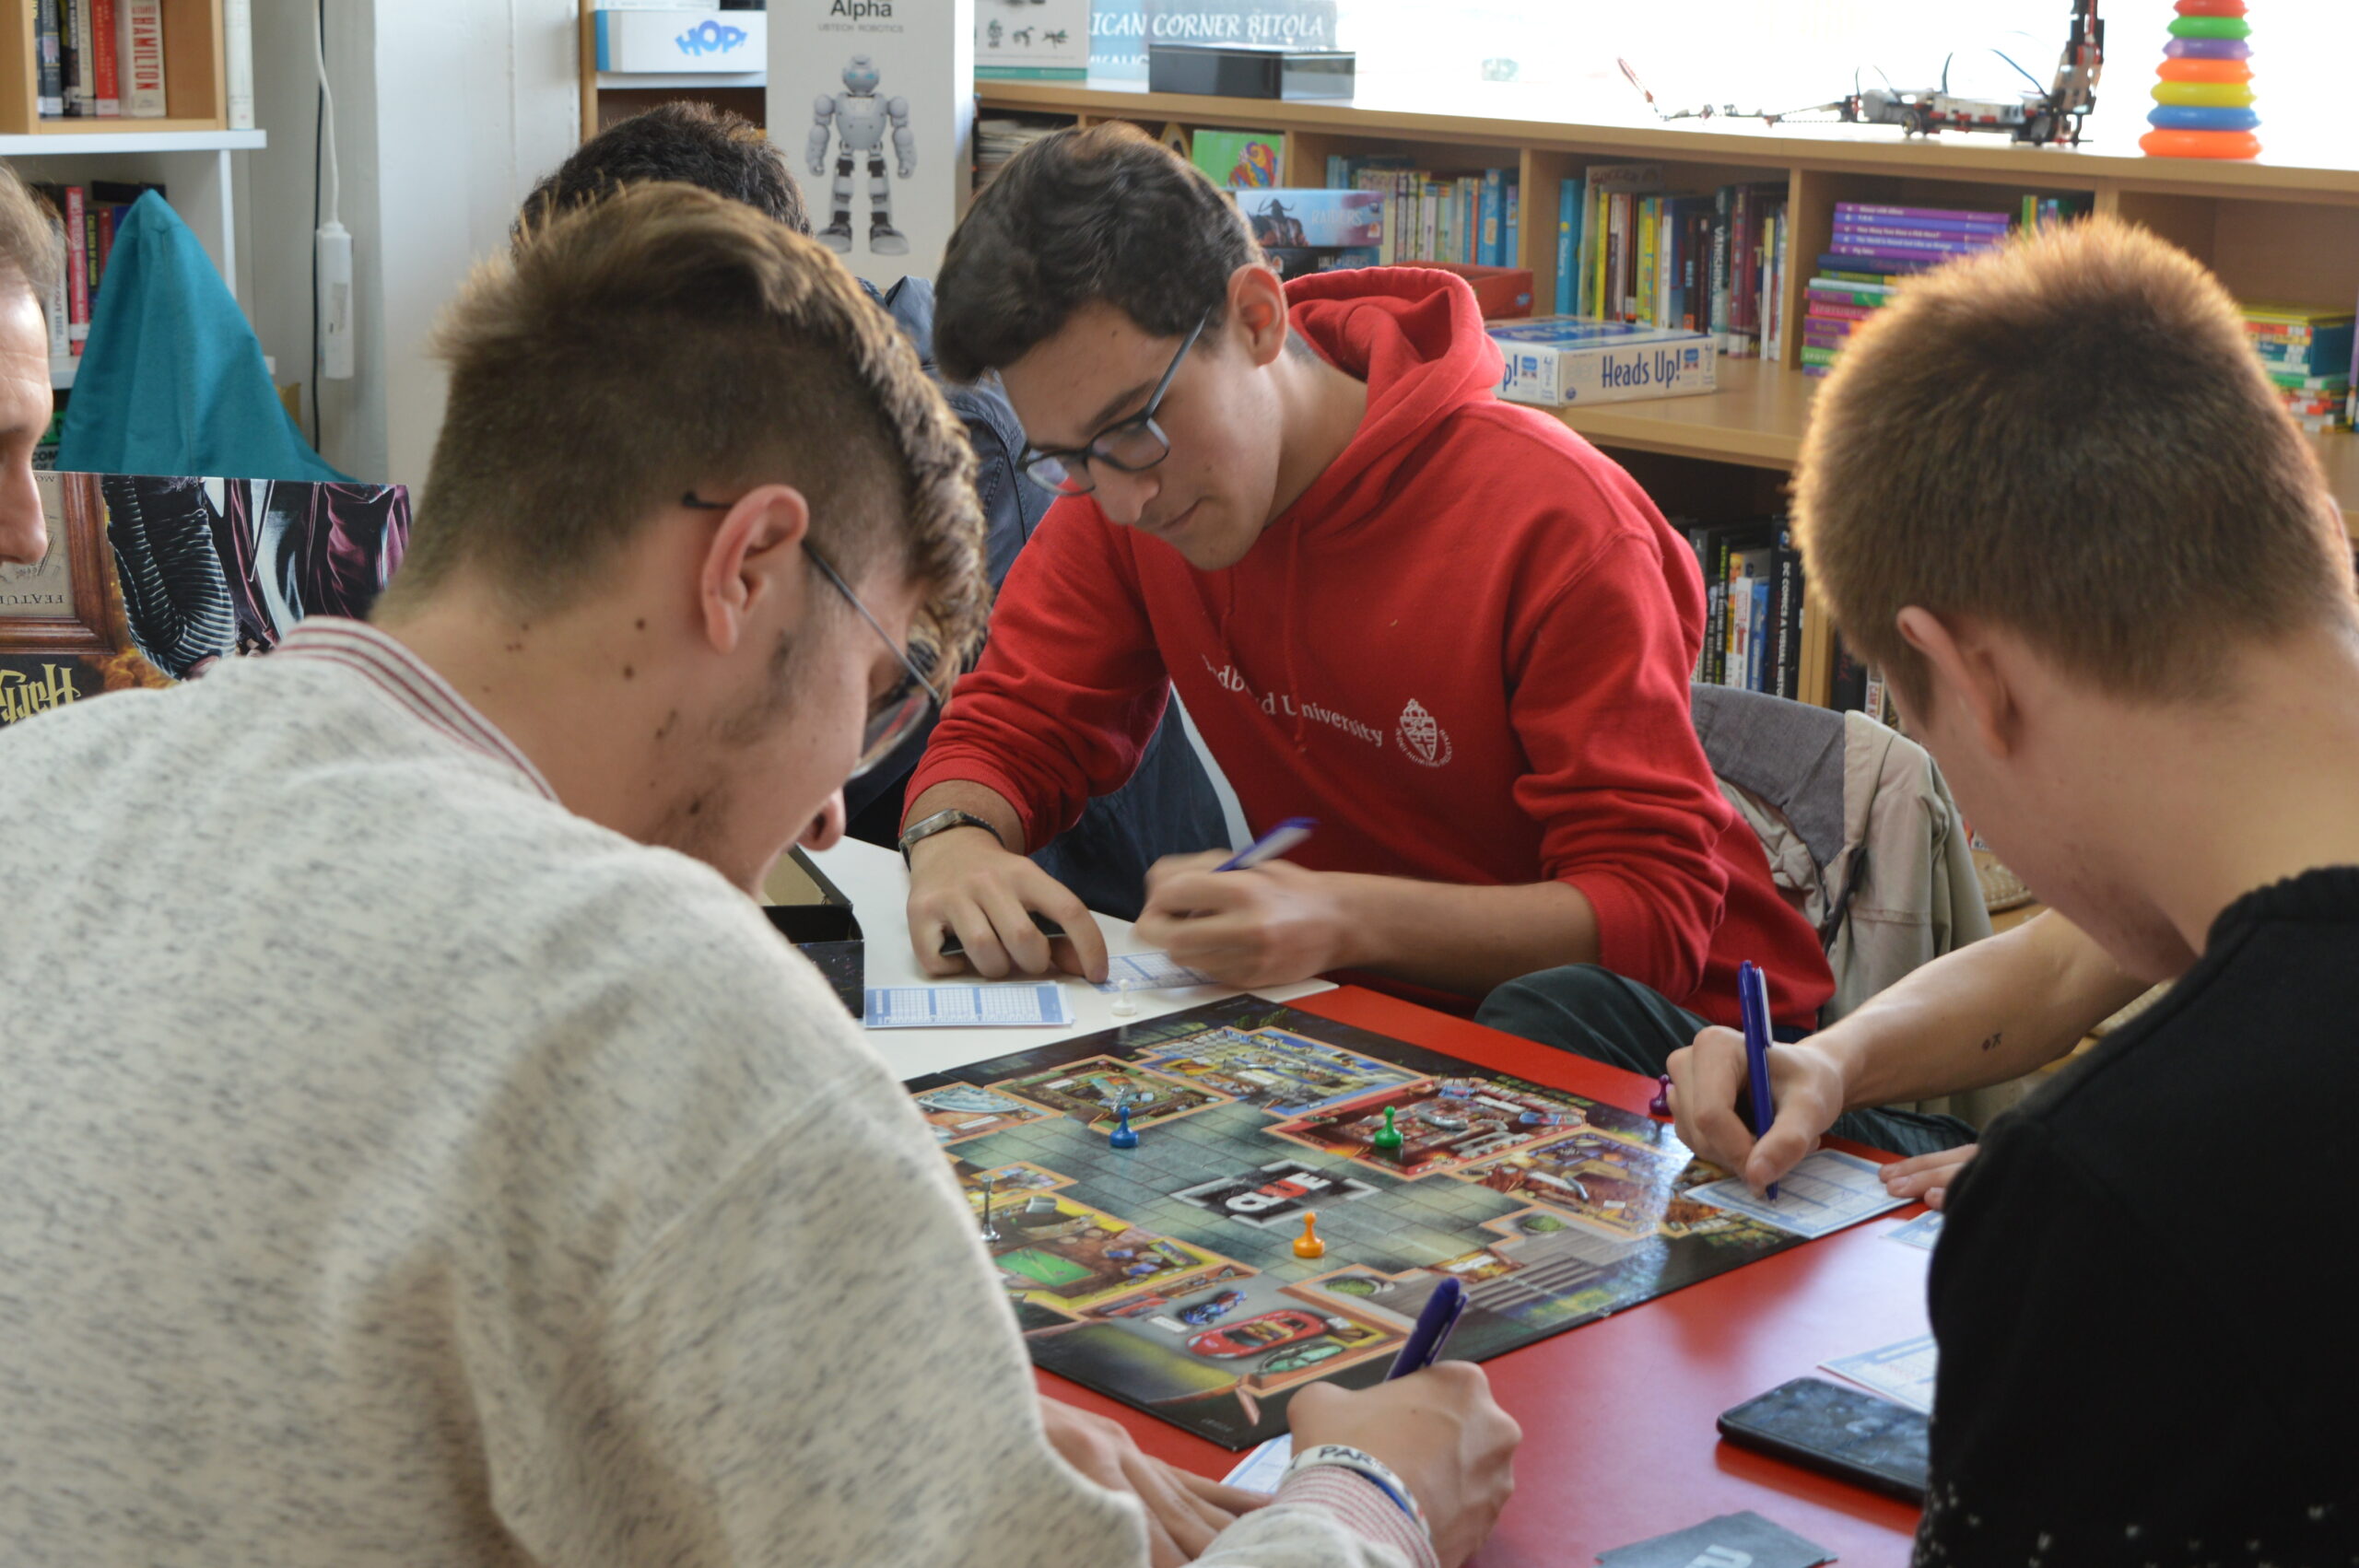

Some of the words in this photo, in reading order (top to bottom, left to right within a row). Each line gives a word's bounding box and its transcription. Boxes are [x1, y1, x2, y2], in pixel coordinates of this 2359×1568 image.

[818, 23, 855, 32] UBTECH
[858, 24, 905, 33] ROBOTICS
[830, 0, 892, 21] Alpha
[1088, 12, 1147, 38] ICAN
[1152, 12, 1240, 38] CORNER
[1247, 13, 1325, 39] BITOLA
[132, 17, 160, 90] HAMILTON
[88, 215, 96, 249] CHILDREN
[1312, 210, 1363, 227] RAIDERS
[1712, 225, 1724, 292] VANISHING
[1503, 353, 1518, 392] p!
[1602, 352, 1650, 388] Heads
[1654, 348, 1681, 389] Up!
[1782, 561, 1790, 577] DC
[1780, 579, 1790, 617] COMICS
[1778, 629, 1787, 664] VISUAL
[1776, 665, 1785, 697] HISTO
[1281, 695, 1382, 748] University
[1225, 1171, 1332, 1211] CLUE
